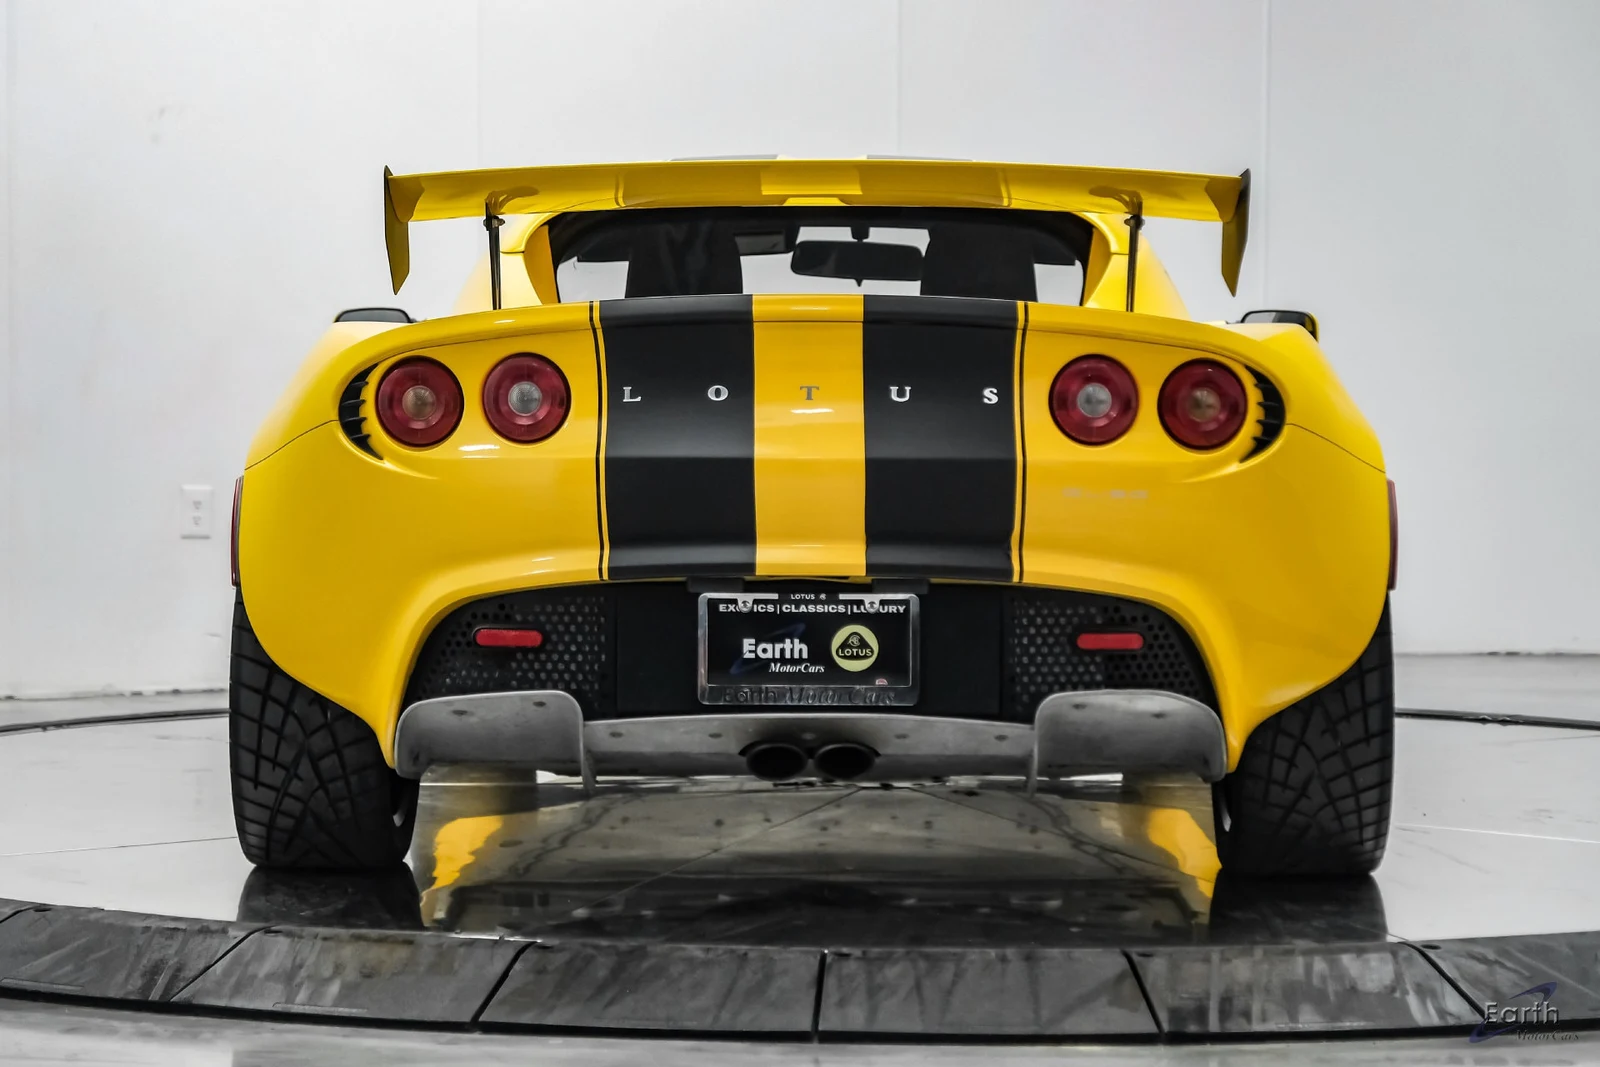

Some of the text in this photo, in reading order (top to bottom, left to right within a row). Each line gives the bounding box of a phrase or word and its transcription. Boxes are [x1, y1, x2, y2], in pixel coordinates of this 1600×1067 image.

[622, 385, 999, 404] LOTUS
[719, 603, 775, 613] EXICS
[782, 604, 846, 613] CLASSICS
[853, 604, 906, 614] LUURY
[742, 638, 809, 659] Earth
[838, 648, 873, 657] LOTUS
[768, 662, 826, 673] MotorCars
